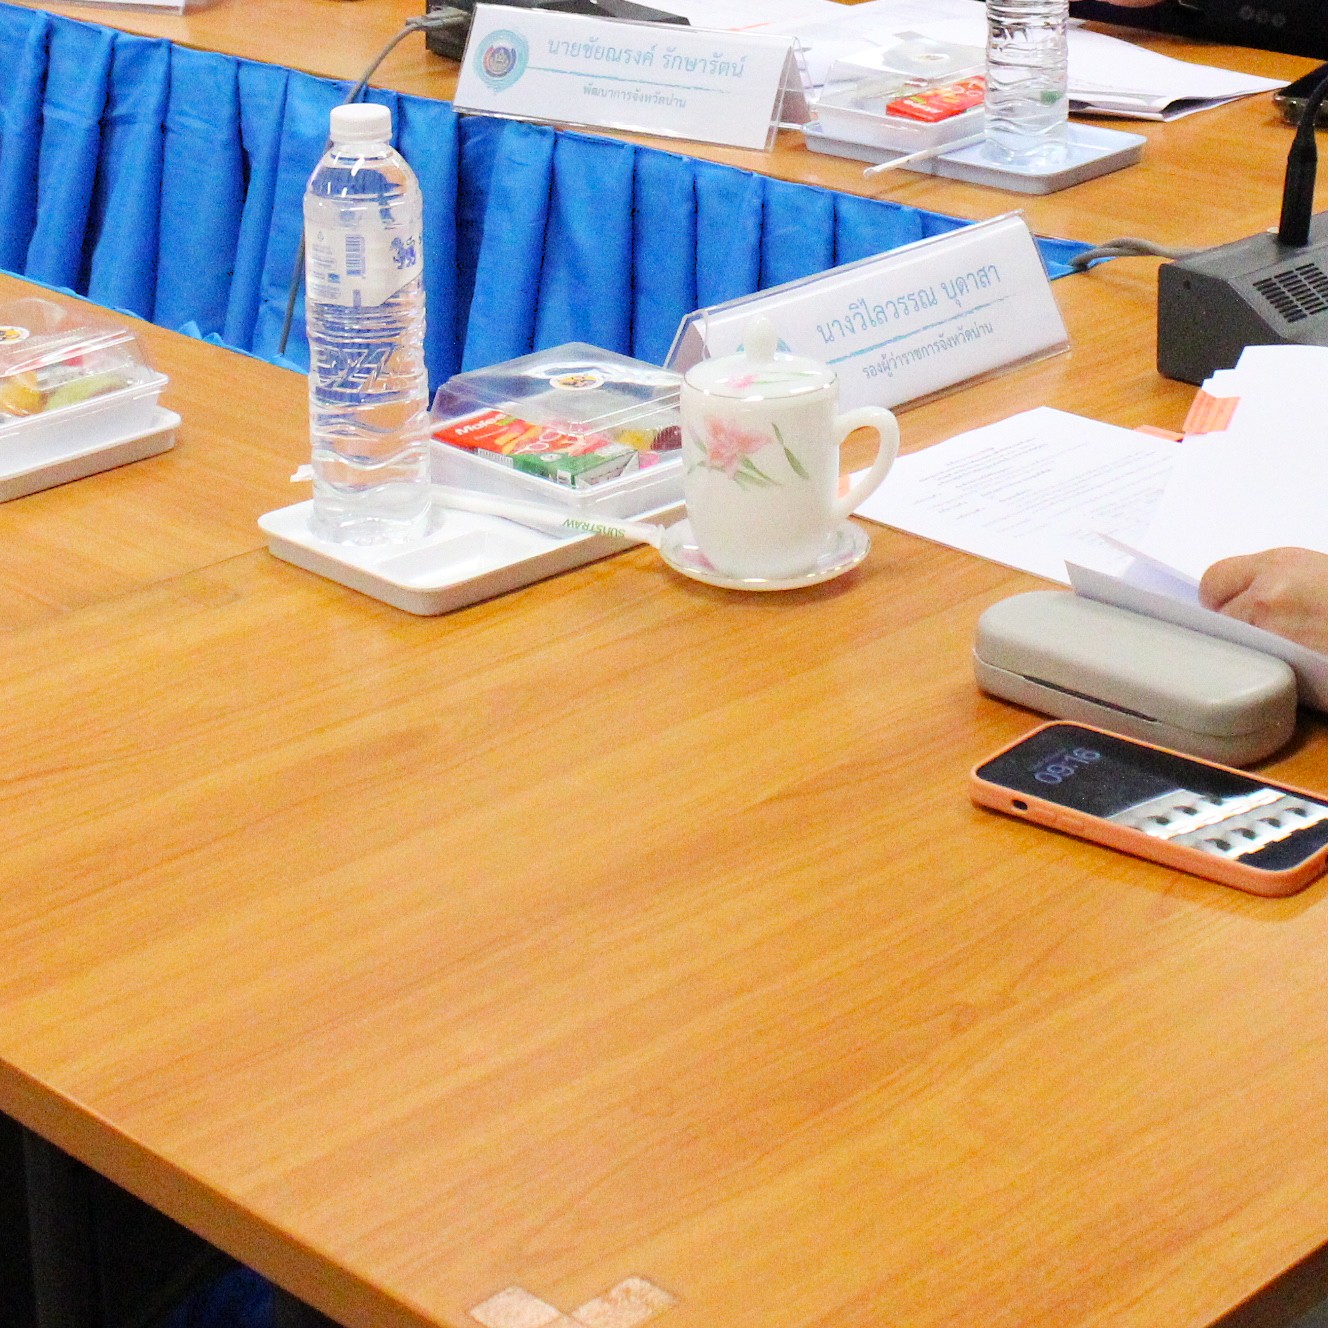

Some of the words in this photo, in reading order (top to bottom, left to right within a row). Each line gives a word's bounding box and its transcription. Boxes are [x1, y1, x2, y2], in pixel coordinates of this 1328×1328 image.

[547, 36, 658, 68] นายชัยณรงค์
[816, 286, 939, 344] นางวิไลวรรณ
